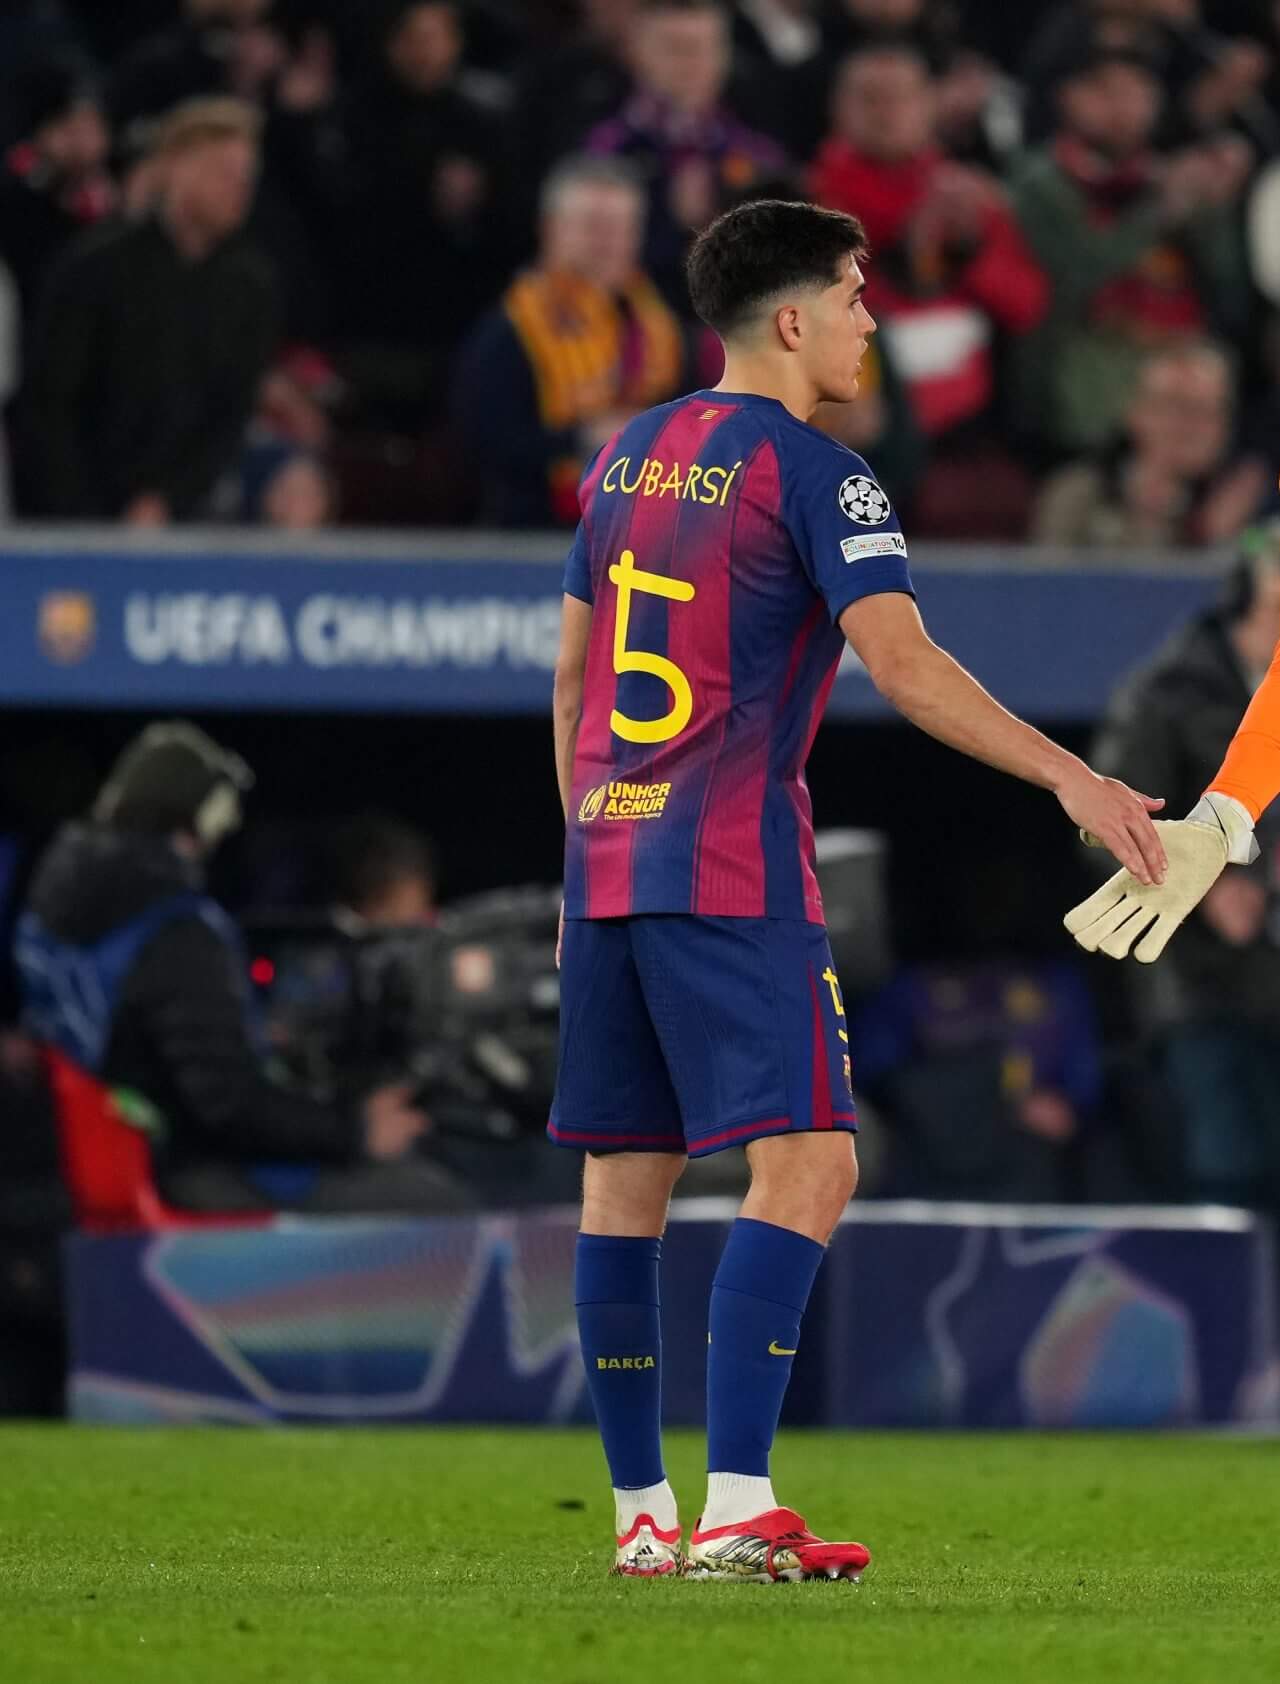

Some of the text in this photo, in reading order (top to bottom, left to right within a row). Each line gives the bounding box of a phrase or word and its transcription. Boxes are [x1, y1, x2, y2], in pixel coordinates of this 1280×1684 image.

[603, 456, 743, 507] CUBARSÍ
[858, 490, 874, 511] 5
[124, 596, 290, 664] UEFA
[609, 550, 695, 744] 5
[608, 782, 672, 800] UNHCR
[604, 798, 666, 815] ACNUR
[597, 1355, 655, 1370] BARÇA
